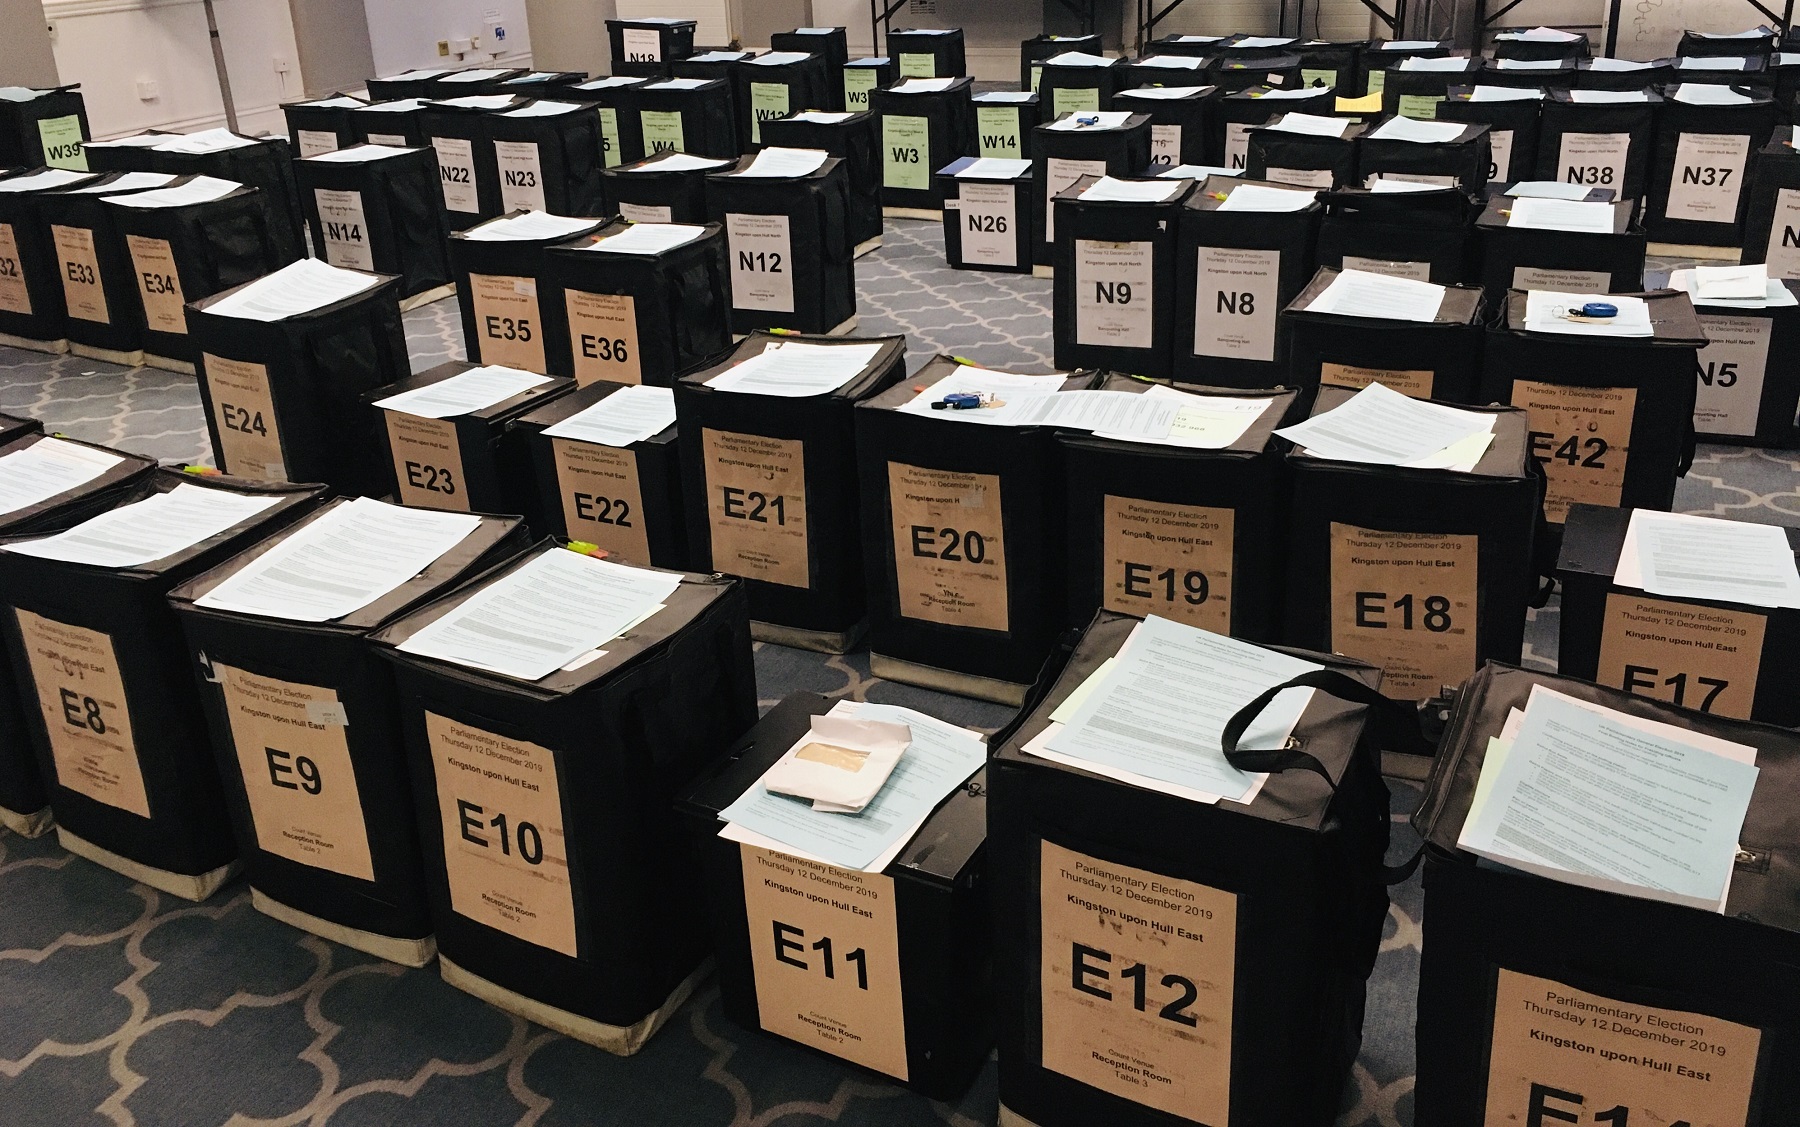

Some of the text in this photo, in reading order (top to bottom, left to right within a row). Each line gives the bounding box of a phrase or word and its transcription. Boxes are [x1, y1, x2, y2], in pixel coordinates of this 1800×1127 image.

[48, 143, 80, 160] W39
[983, 135, 1016, 149] W14
[893, 147, 919, 164] W3
[441, 166, 470, 184] N22
[505, 170, 536, 187] N23
[1567, 166, 1613, 185] N38
[1683, 166, 1733, 186] N37
[328, 222, 362, 242] N14
[969, 215, 1007, 233] N26
[0, 257, 18, 278] 32
[67, 262, 95, 285] E33
[739, 251, 782, 273] N12
[142, 273, 175, 295] E34
[1096, 281, 1131, 305] N9
[1217, 291, 1255, 316] N8
[486, 316, 532, 342] E35
[581, 334, 628, 363] E36
[1386, 372, 1411, 380] Election
[1697, 362, 1738, 387] N5
[1526, 387, 1556, 395] Thursday
[1569, 390, 1603, 399] December
[1529, 402, 1561, 411] Kingston
[222, 402, 267, 437] E24
[1528, 431, 1608, 469] E42
[719, 457, 745, 467] Kingston
[746, 462, 761, 470] upon
[405, 461, 455, 495] E23
[900, 478, 927, 488] Thursday
[909, 470, 950, 481] Parliamentary
[574, 492, 632, 528] E22
[724, 487, 785, 526] E21
[936, 497, 953, 505] upon
[1128, 505, 1208, 519] Parliamentary Election
[1118, 512, 1149, 524] Thursday
[1162, 518, 1198, 529] December
[911, 525, 985, 564] E20
[1122, 529, 1155, 540] Kingston
[1157, 535, 1177, 543] upon
[1346, 539, 1382, 549] Thursday
[1358, 530, 1413, 540] Parliamentary
[1352, 557, 1389, 567] Kingston
[1416, 559, 1433, 567] Hull
[1125, 562, 1209, 605] E19
[1356, 592, 1451, 633] E18
[1636, 605, 1733, 624] Parliamentary Election
[1622, 612, 1747, 637] Thursday 12 December 2019
[1626, 630, 1737, 653] Kingston upon Hull East
[271, 695, 306, 710] December
[284, 689, 312, 700] Election
[59, 687, 106, 735] E8
[240, 705, 326, 731] Kingston upon Hull East
[451, 726, 530, 757] Parliamentary Election
[441, 735, 543, 772] Thursday 12 December 2019
[265, 747, 322, 795] E9
[448, 757, 540, 792] Kingston upon Hull East
[457, 799, 543, 866] E10
[757, 856, 878, 900] Thursday 12 December 2019
[769, 850, 863, 883] Parliamentary Election
[1075, 862, 1195, 901] Parliamentary Election
[764, 879, 873, 919] Kingston upon Hull East
[1060, 869, 1213, 920] Thursday 12 December 2019
[515, 907, 537, 919] Room
[1067, 894, 1204, 943] Kingston upon Hull East
[773, 920, 868, 991] E11
[1072, 942, 1198, 1028] E12
[1547, 991, 1704, 1036] Parliamentary Election
[798, 1014, 862, 1042] Reception Room
[816, 1029, 838, 1042] Table
[1523, 999, 1726, 1057] Thursday 12 December 2019
[1109, 1049, 1155, 1069] Count Venue
[1530, 1029, 1711, 1082] Kingston upon Hull East
[1092, 1051, 1172, 1085] Reception Room
[1115, 1070, 1139, 1085] Table
